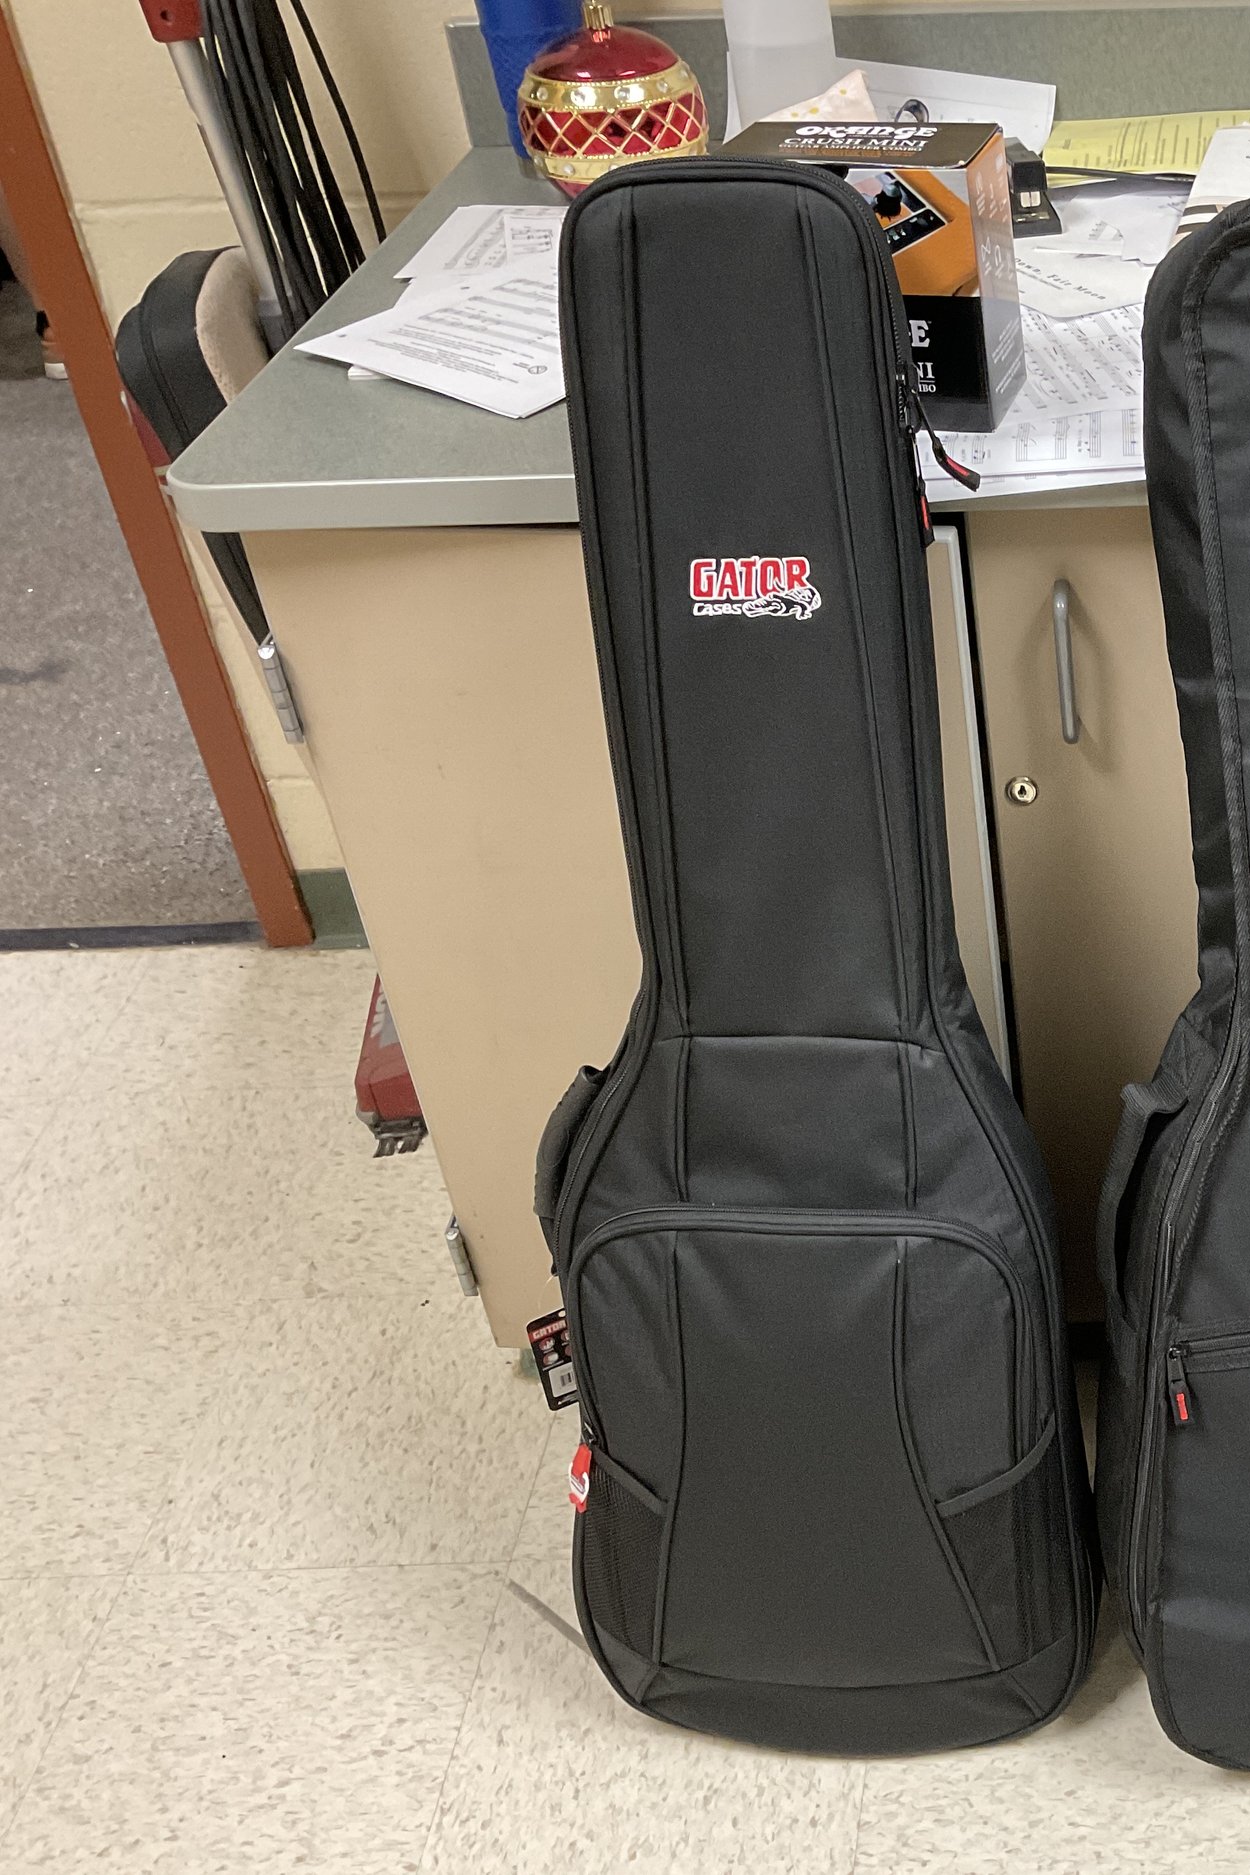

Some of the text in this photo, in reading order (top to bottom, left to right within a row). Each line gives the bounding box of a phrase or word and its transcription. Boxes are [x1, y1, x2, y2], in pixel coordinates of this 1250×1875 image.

[796, 126, 938, 140] ORANGE
[784, 137, 929, 148] CRUSH MINI
[690, 556, 811, 601] GATOR
[532, 1319, 567, 1340] GATOR
